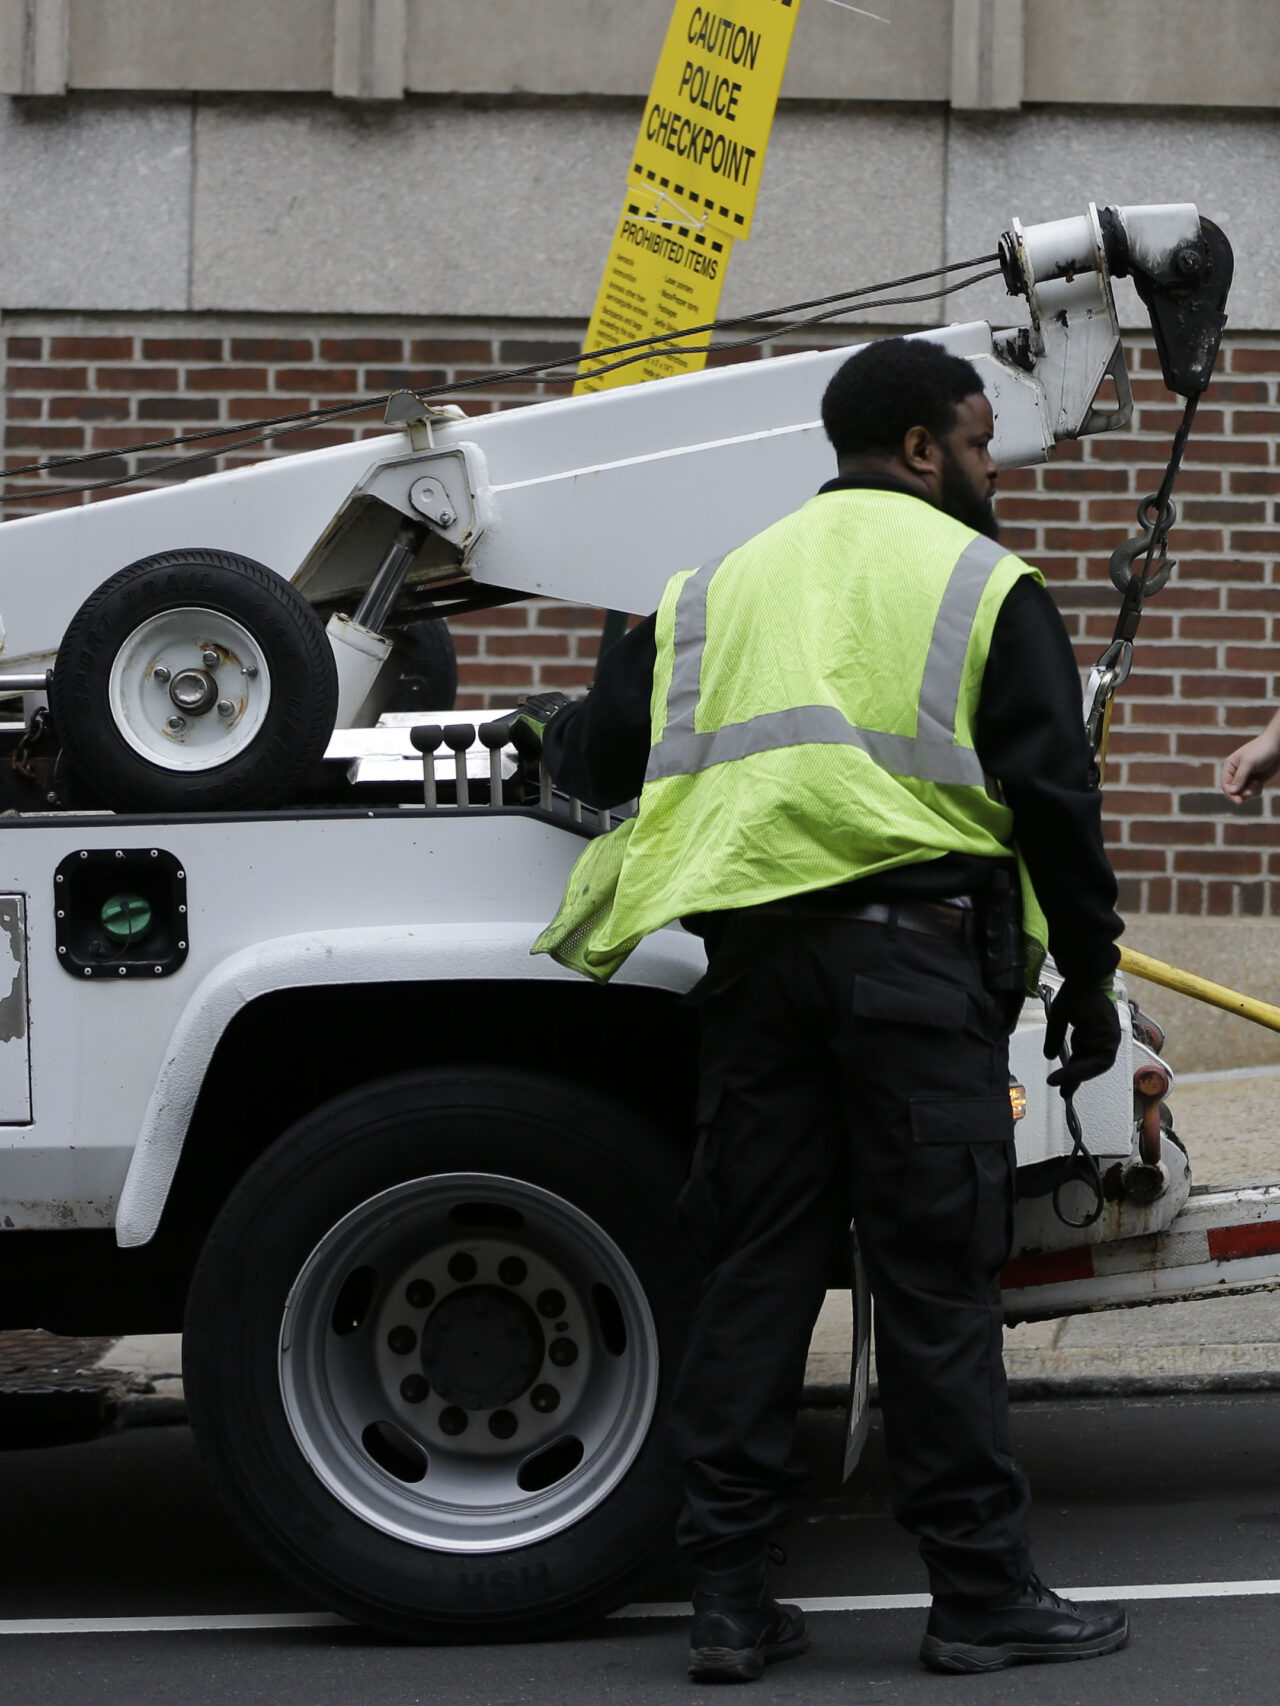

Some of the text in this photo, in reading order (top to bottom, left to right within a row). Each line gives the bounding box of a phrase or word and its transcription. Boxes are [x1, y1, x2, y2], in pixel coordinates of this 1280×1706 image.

[687, 7, 761, 70] CAUTION
[678, 61, 742, 121] POLICE
[646, 104, 756, 186] CHECKPOINT
[620, 220, 719, 281] PROHIBITED ITEMS
[121, 573, 217, 611] TRAIL
